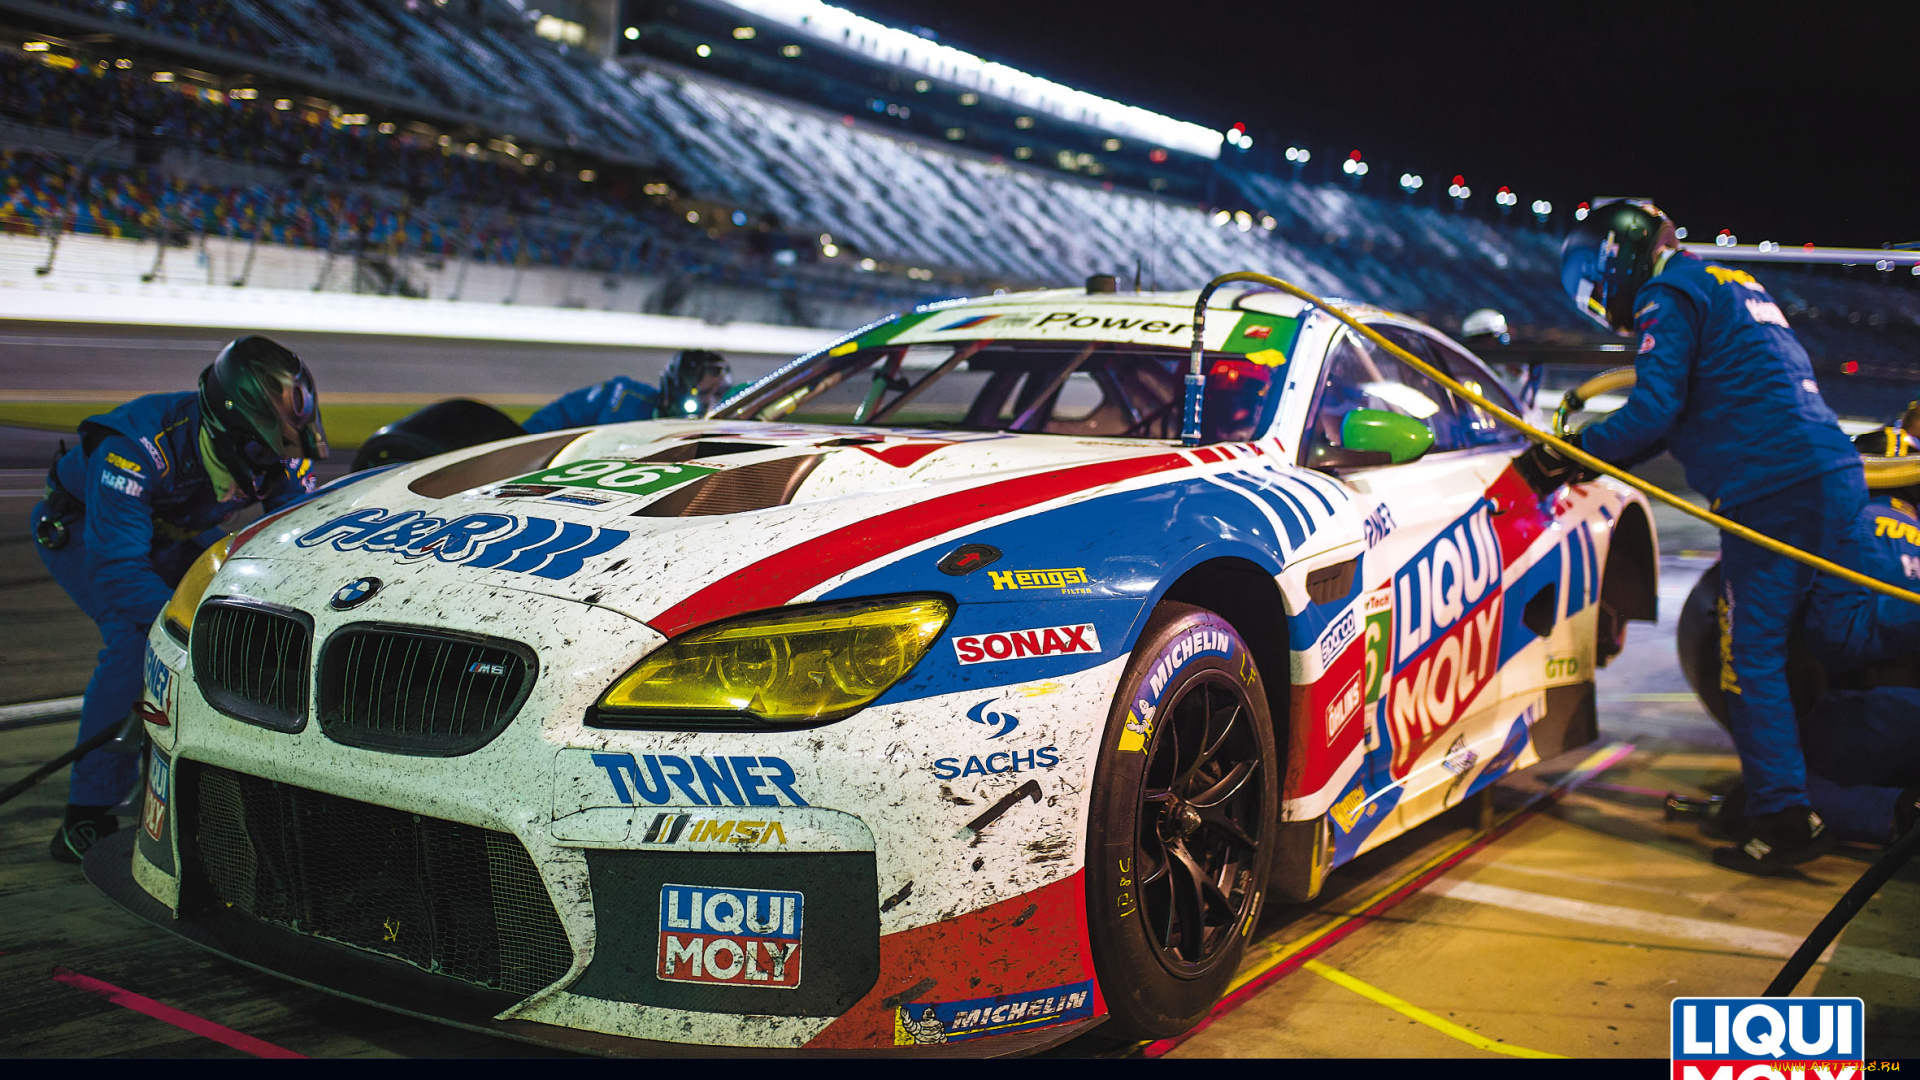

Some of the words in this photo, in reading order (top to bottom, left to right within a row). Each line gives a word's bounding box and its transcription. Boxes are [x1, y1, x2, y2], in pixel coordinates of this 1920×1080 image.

[1035, 312, 1195, 335] Power
[541, 461, 683, 488] 96
[295, 507, 520, 563] H&R
[987, 567, 1089, 591] Hengst
[1061, 587, 1092, 595] FILTER
[1399, 506, 1500, 665] LIQUI
[956, 624, 1094, 663] SONAX
[1149, 631, 1229, 700] MICHELIN
[1546, 657, 1579, 679] GTD
[1393, 597, 1501, 774] MOLY
[591, 754, 809, 806] TURNER
[934, 746, 1060, 780] SACHS
[688, 820, 787, 845] IMSA
[667, 890, 798, 936] LIQUI
[664, 935, 799, 982] MOLY
[951, 990, 1088, 1030] MICHELIN
